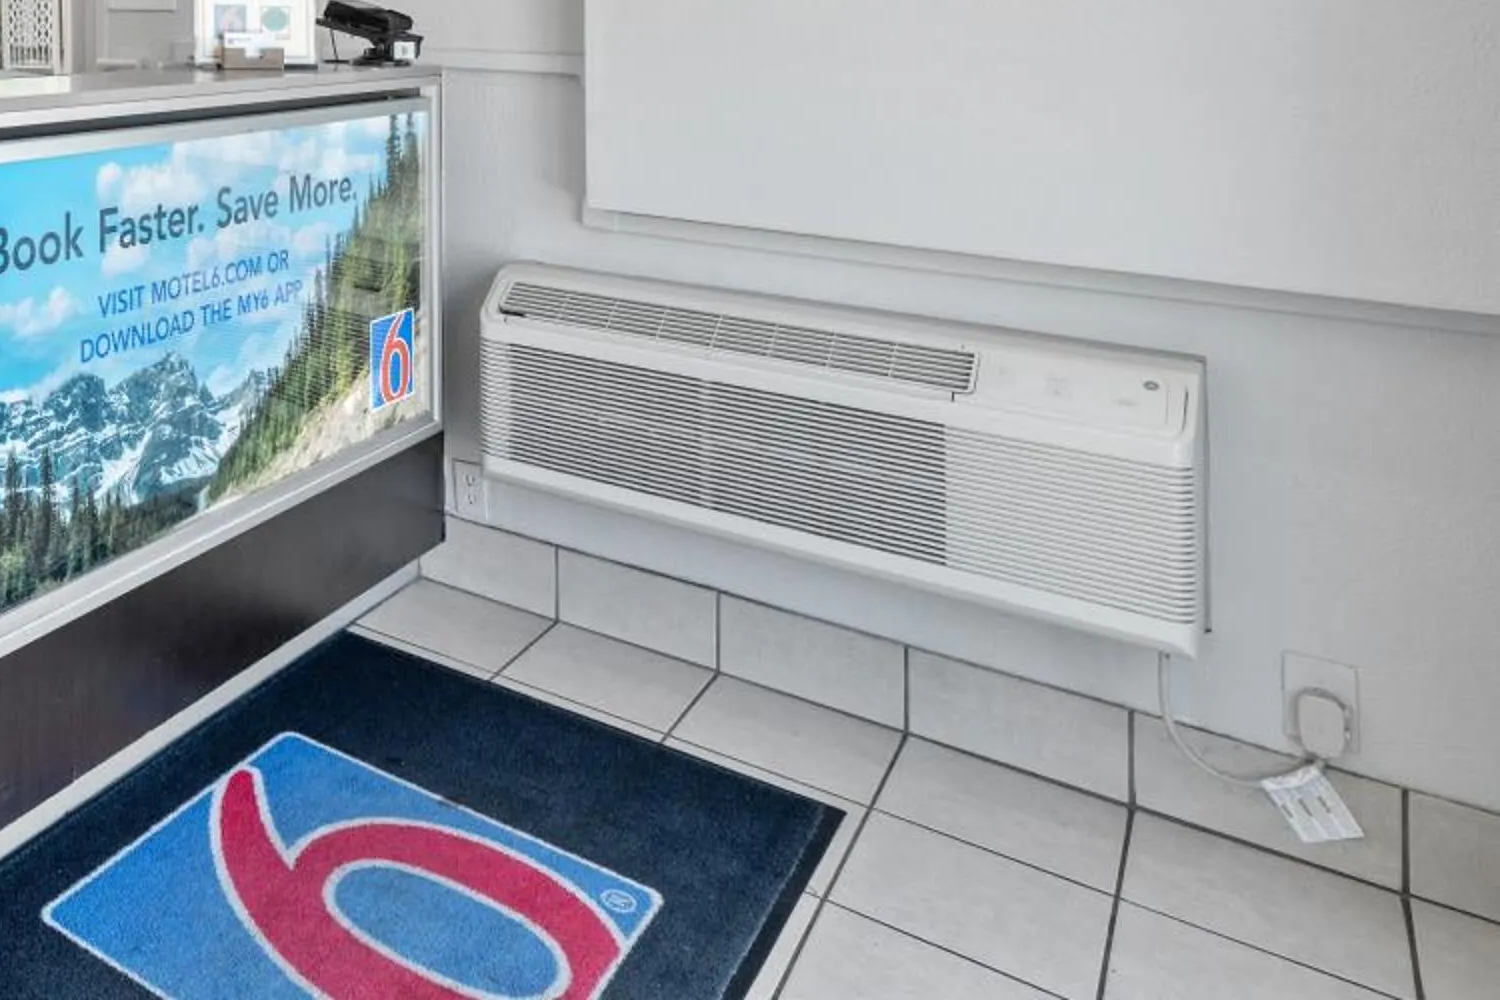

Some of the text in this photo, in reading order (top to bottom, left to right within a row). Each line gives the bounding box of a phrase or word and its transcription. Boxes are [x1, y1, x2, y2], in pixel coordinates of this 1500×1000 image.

[99, 203, 205, 254] Faster.
[216, 186, 279, 229] Save
[288, 174, 358, 213] More.
[80, 278, 304, 364] DOWNLOAD THE MY6 APP
[98, 249, 290, 319] VISIT MOTEL6.COM OR
[380, 311, 411, 405] 6
[211, 764, 628, 1000] 6
